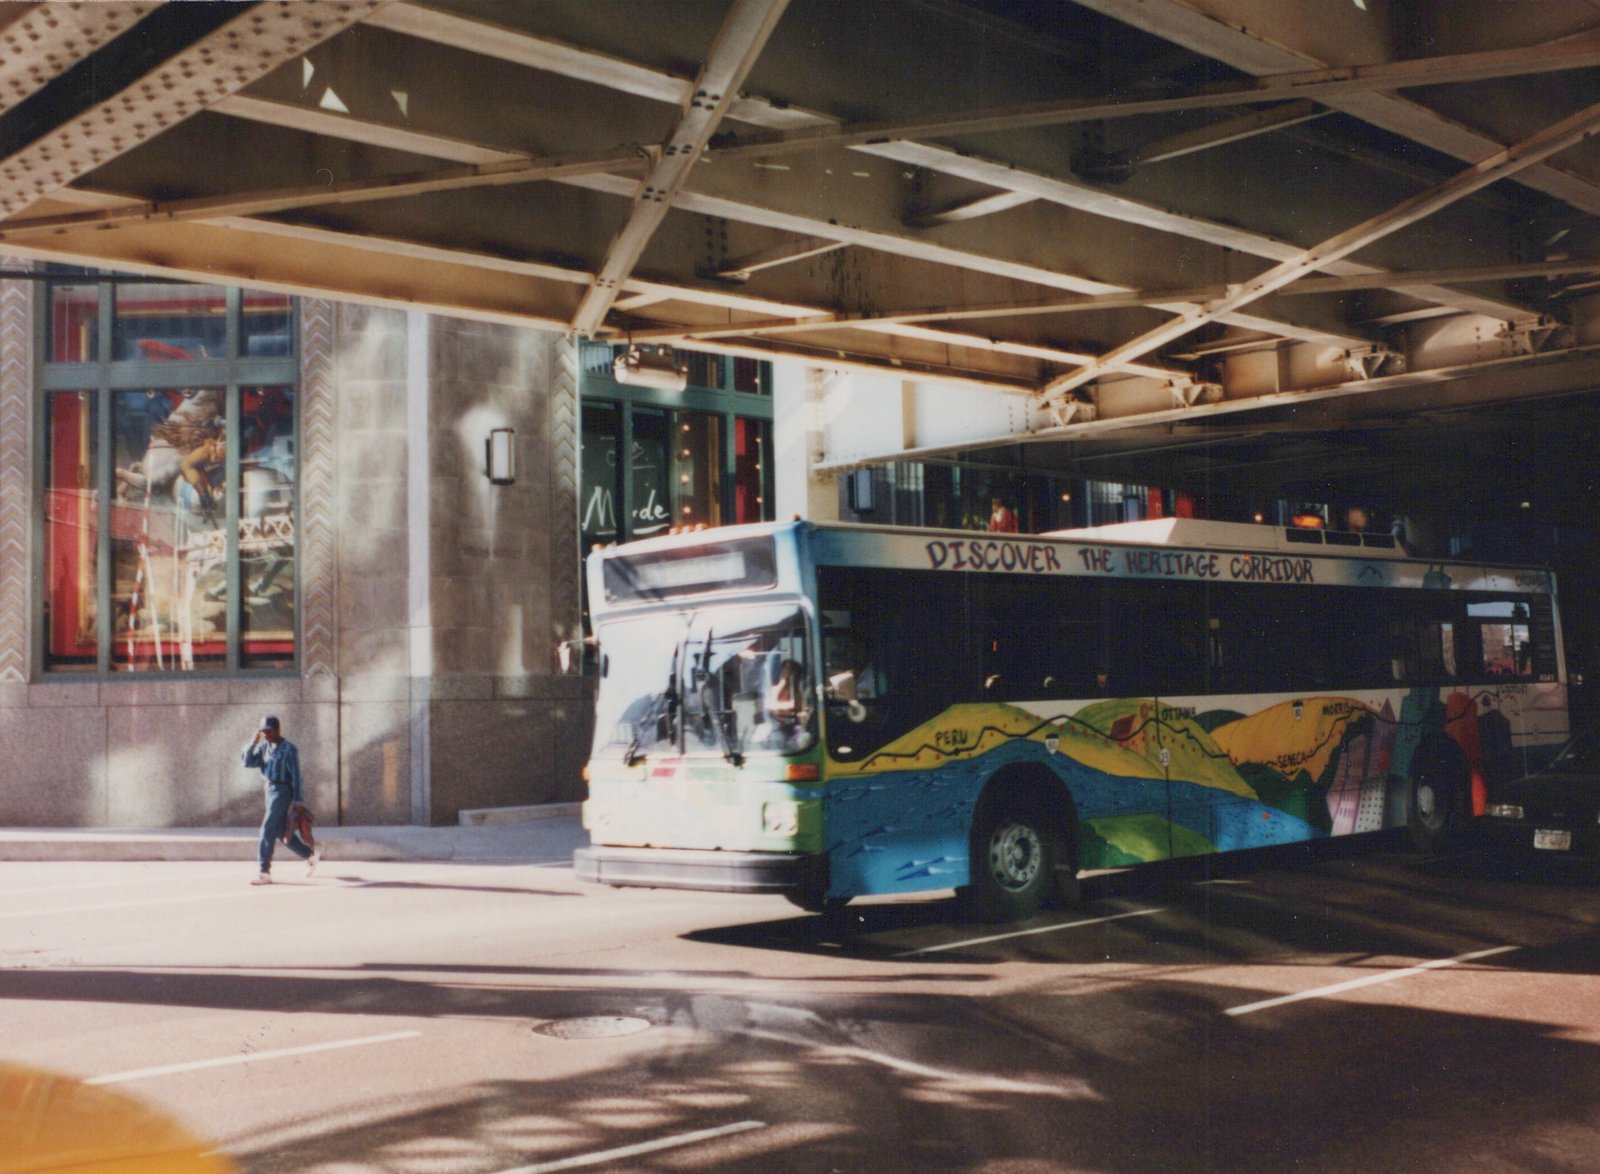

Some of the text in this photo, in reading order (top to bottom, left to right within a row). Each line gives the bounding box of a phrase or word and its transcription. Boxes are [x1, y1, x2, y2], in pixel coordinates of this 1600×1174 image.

[926, 540, 1313, 583] DISCOVER THE HERITAGE CORRIDOR
[934, 728, 968, 747] PERU
